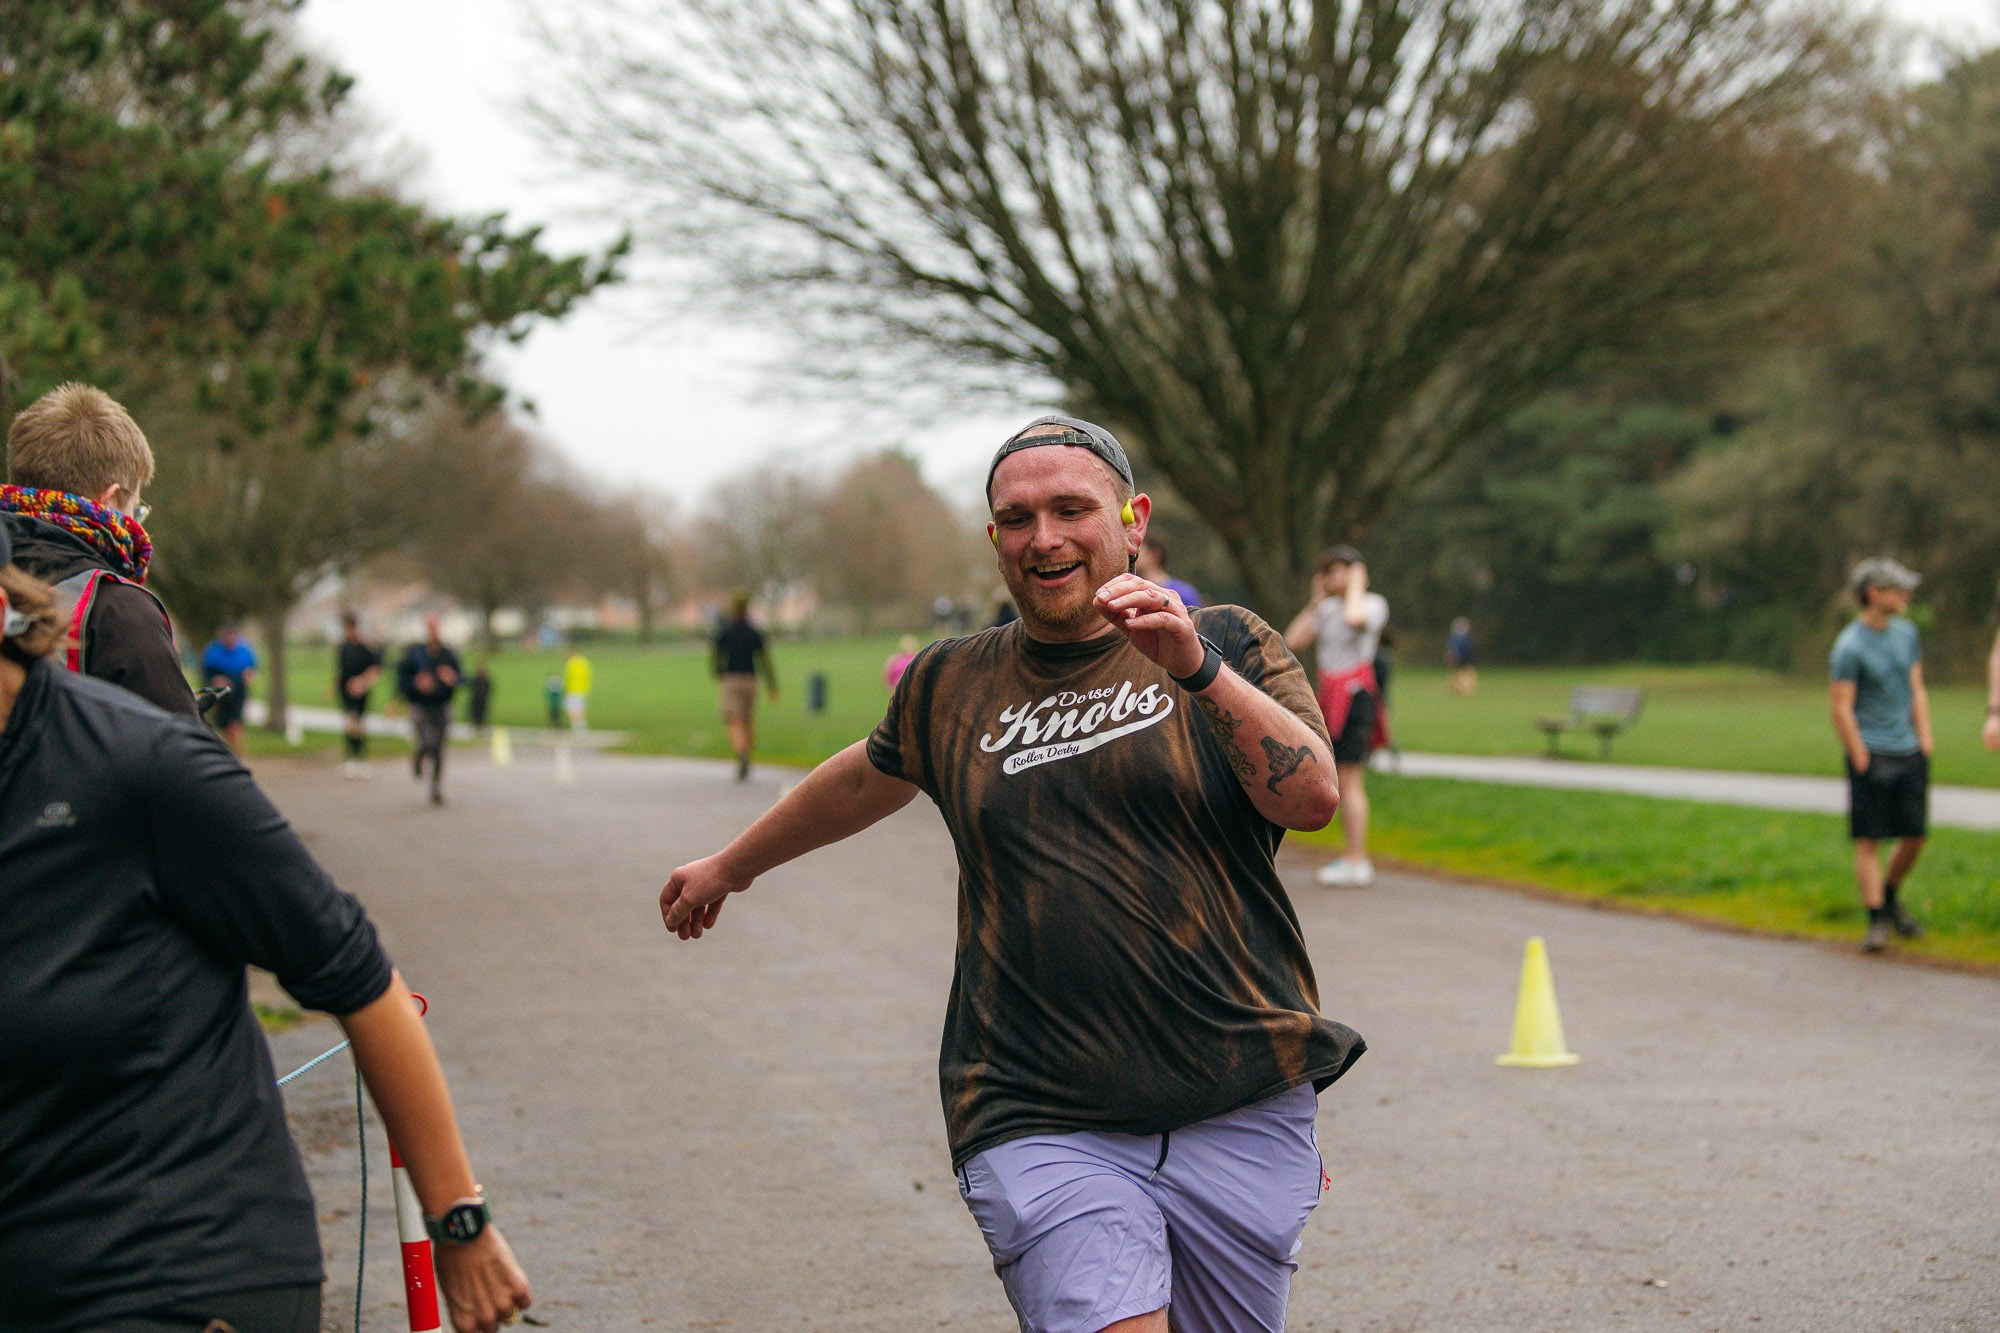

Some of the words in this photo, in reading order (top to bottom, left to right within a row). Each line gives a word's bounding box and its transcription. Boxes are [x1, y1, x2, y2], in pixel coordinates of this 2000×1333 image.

[980, 680, 1160, 752] Knobs
[1011, 749, 1044, 768] Roller
[1046, 742, 1080, 757] Derby
